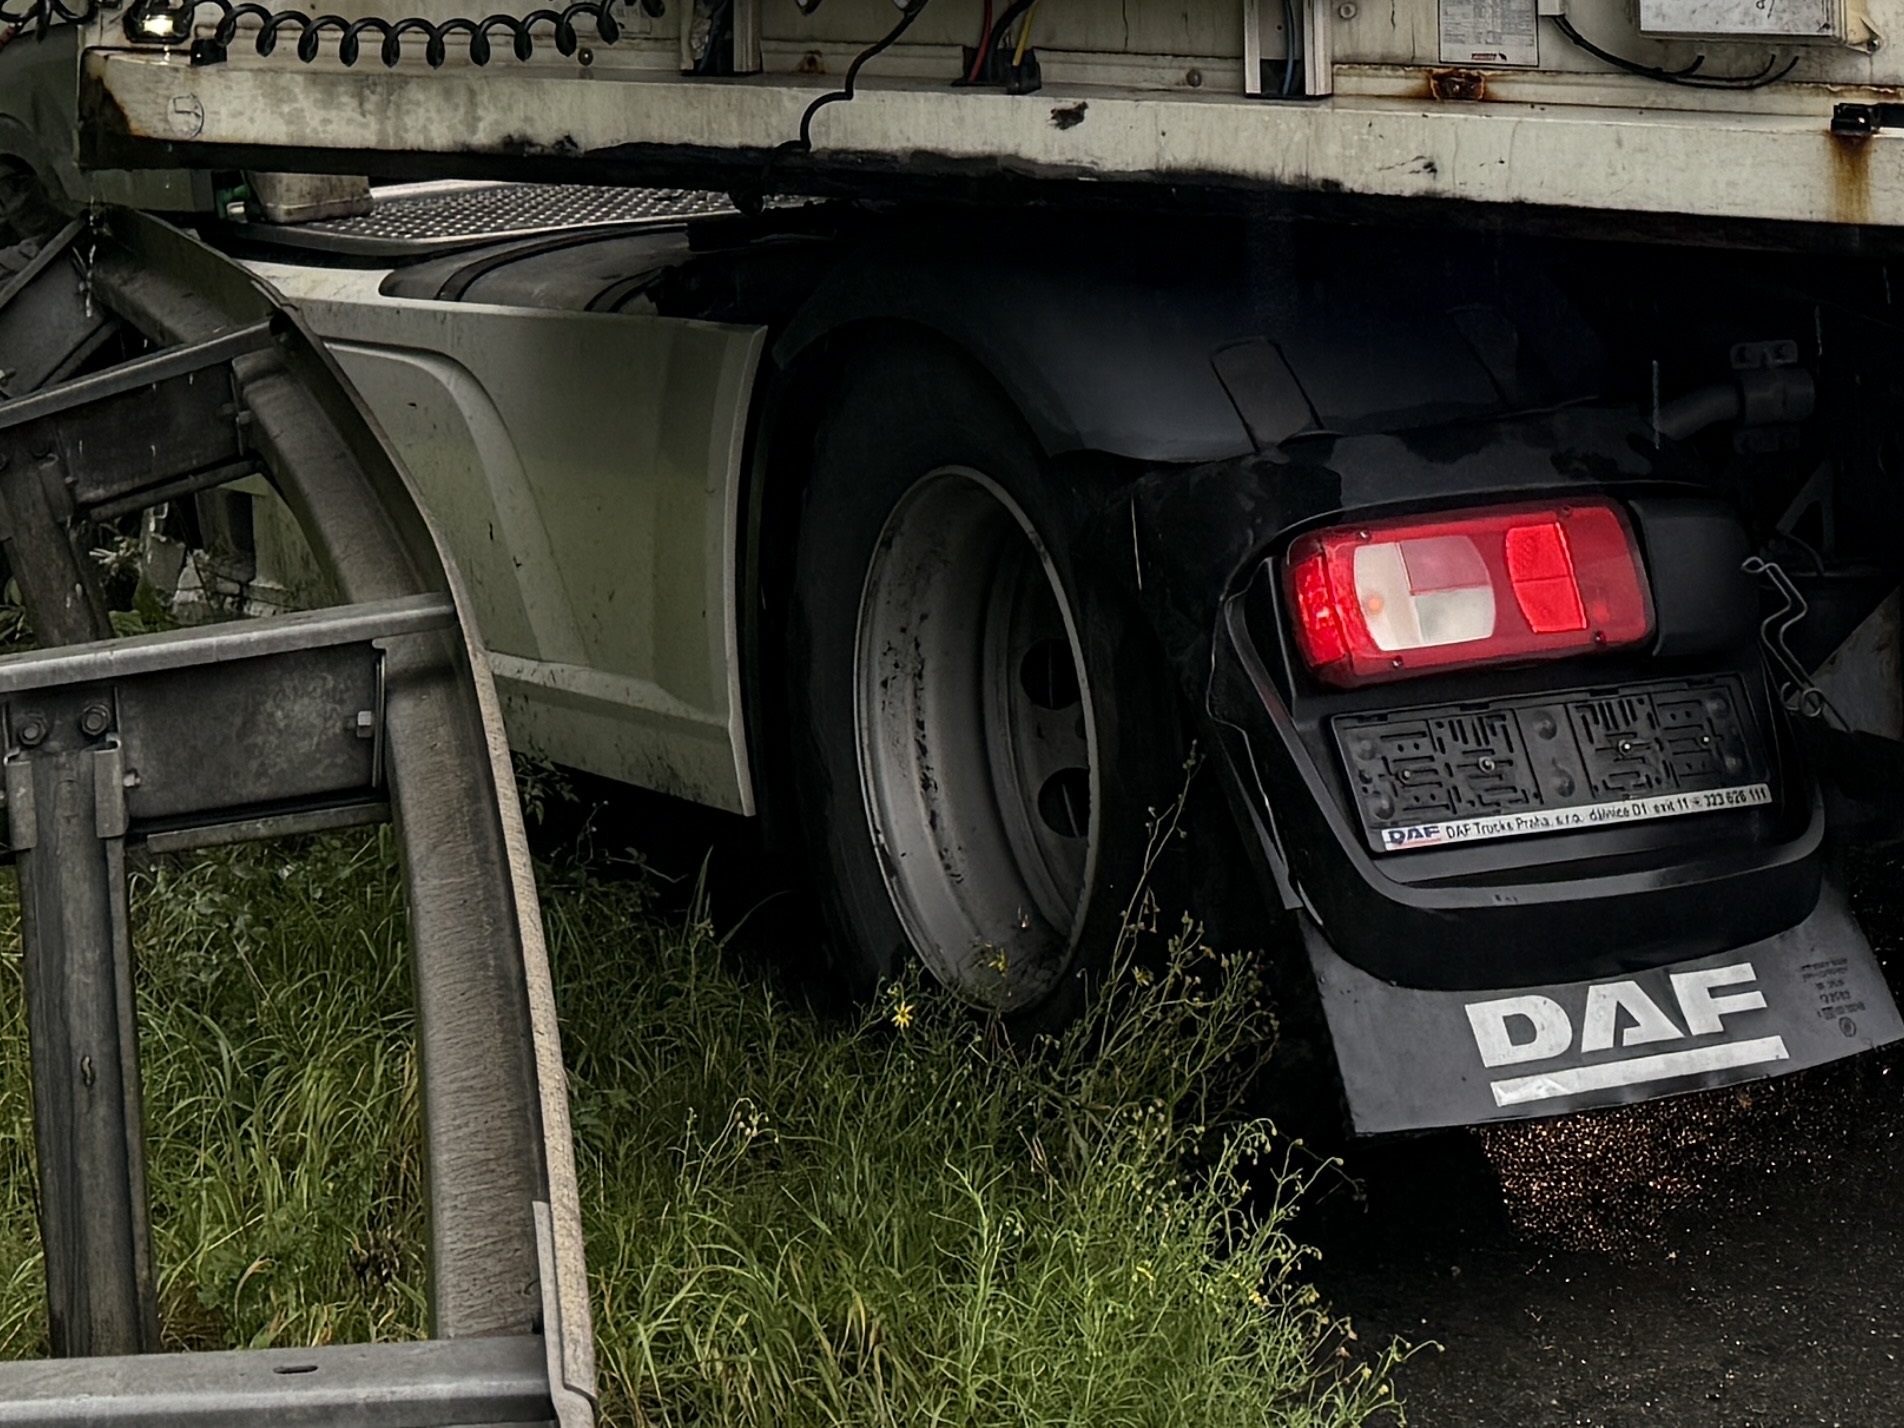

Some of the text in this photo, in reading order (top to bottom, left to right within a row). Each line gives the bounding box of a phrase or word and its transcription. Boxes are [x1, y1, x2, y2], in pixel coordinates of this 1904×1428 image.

[1387, 825, 1441, 845] DAF
[1445, 825, 1472, 839] DAF
[1464, 961, 1769, 1069] DAF
